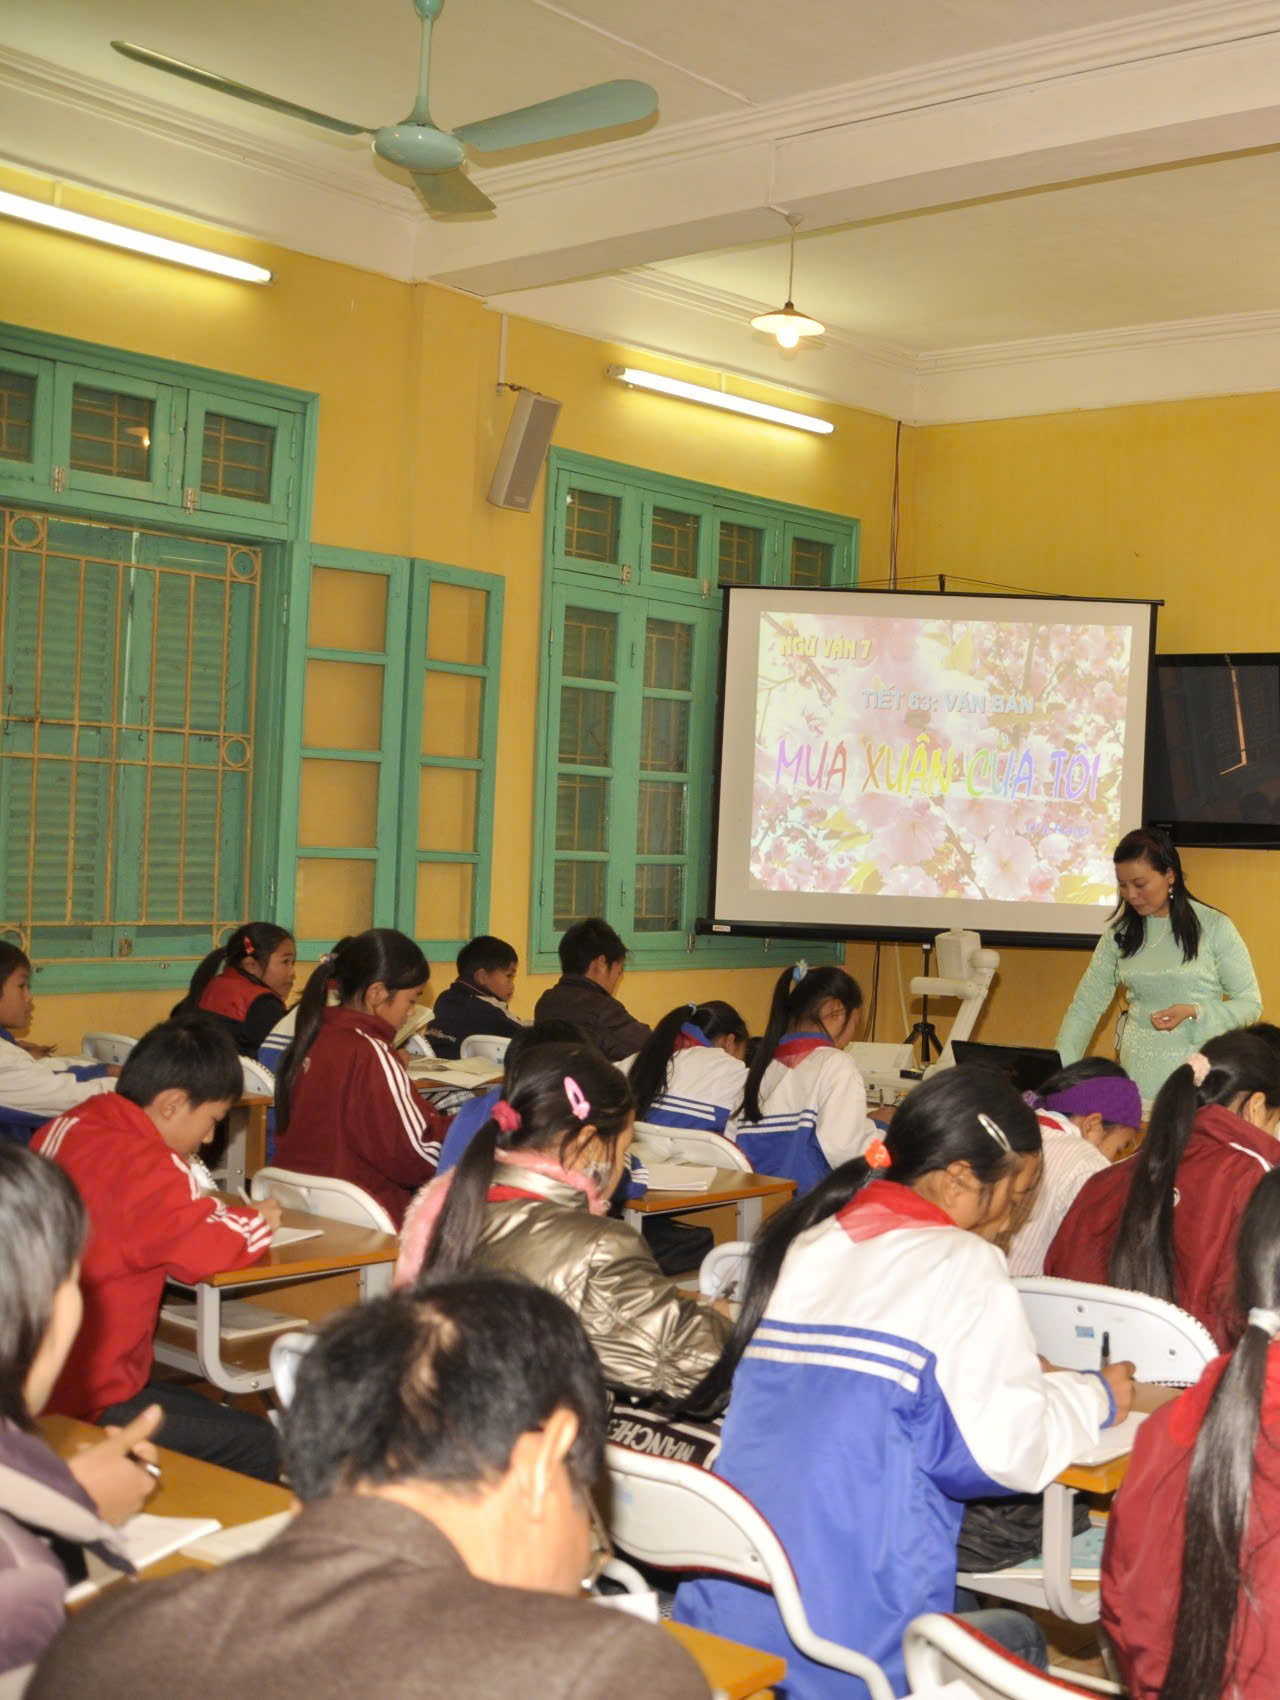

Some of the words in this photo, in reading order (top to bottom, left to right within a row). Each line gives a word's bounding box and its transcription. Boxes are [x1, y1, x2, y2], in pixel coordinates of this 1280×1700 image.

[862, 639, 872, 659] 7
[862, 685, 905, 711] TIẾT
[909, 691, 938, 712] 63:
[989, 689, 1034, 714] BẢN
[861, 733, 955, 796] XUÂN
[966, 735, 1034, 799] CỦA
[1049, 743, 1101, 800] TÔI
